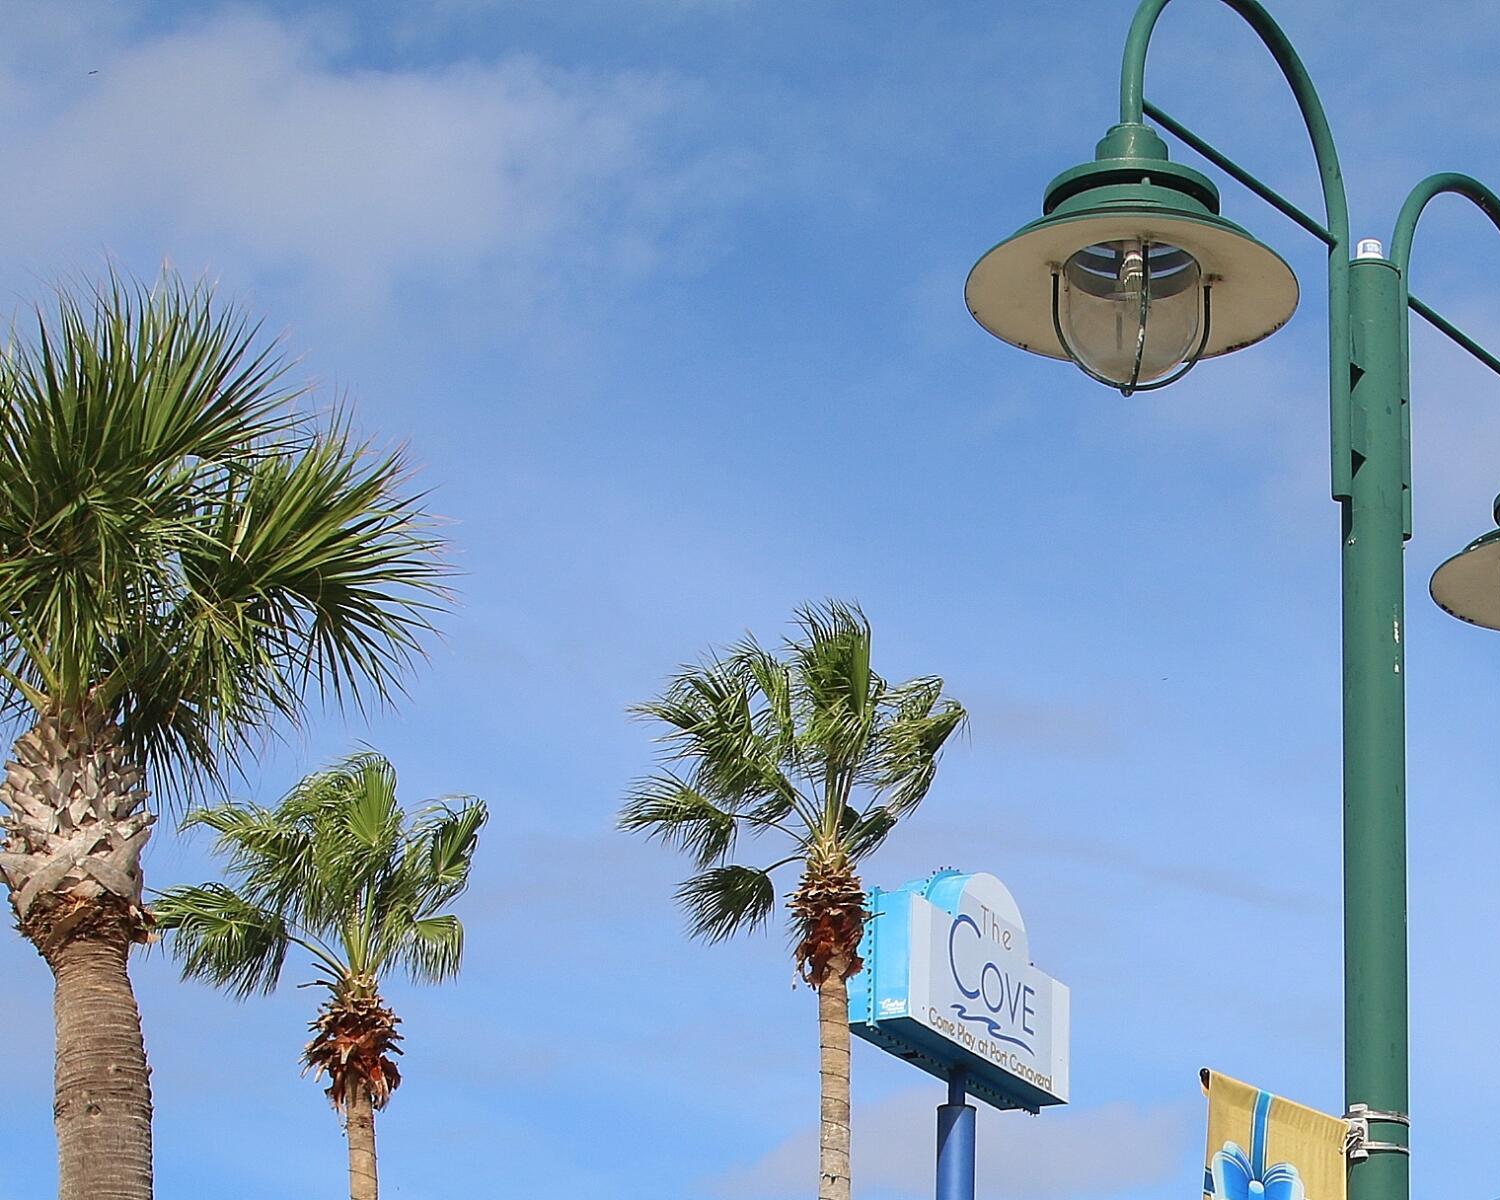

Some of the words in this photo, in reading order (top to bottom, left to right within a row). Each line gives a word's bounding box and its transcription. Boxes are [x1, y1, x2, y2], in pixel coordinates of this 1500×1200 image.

[981, 905, 1012, 950] The
[949, 914, 1035, 1036] COVE
[928, 1007, 956, 1036] Come
[958, 1023, 976, 1050] Play
[978, 1040, 988, 1054] at
[990, 1043, 1008, 1066] Port
[1010, 1054, 1053, 1091] Canaveral
